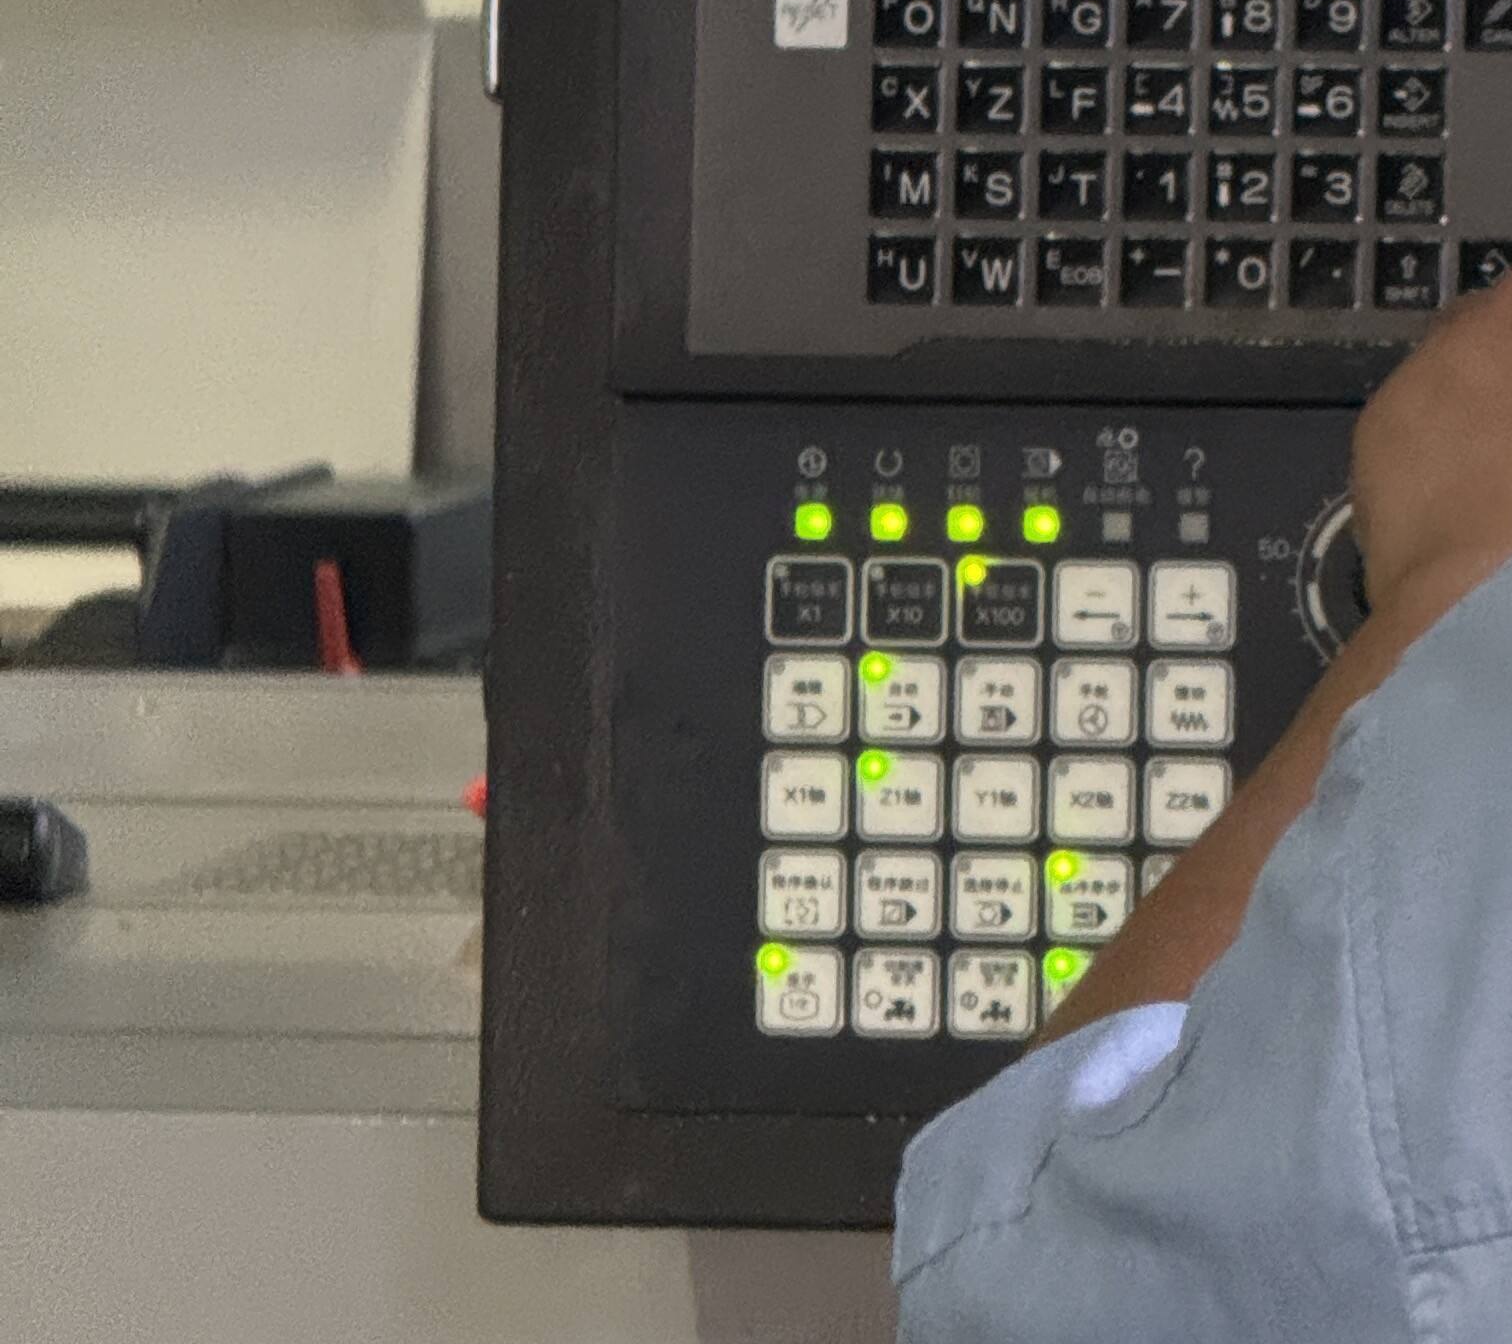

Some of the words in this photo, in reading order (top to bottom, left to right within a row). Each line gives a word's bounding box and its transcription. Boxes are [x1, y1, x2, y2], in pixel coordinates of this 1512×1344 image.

[989, 1, 1016, 35] N
[1072, 0, 1101, 35] G
[903, 85, 931, 119] X
[987, 87, 1014, 120] Z
[1049, 78, 1065, 98] L
[1071, 87, 1098, 120] F
[1158, 84, 1186, 118] 4
[1242, 84, 1271, 119] 5
[1325, 85, 1354, 120] 6
[900, 170, 930, 206] M
[985, 171, 1013, 206] S
[1048, 163, 1066, 185] J
[1069, 173, 1097, 206] T
[1159, 170, 1177, 203] 1
[1240, 170, 1269, 205] 2
[1323, 170, 1353, 206] 3
[877, 248, 894, 268] H
[899, 258, 927, 291] U
[981, 258, 1014, 292] W
[1256, 537, 1292, 560] 50
